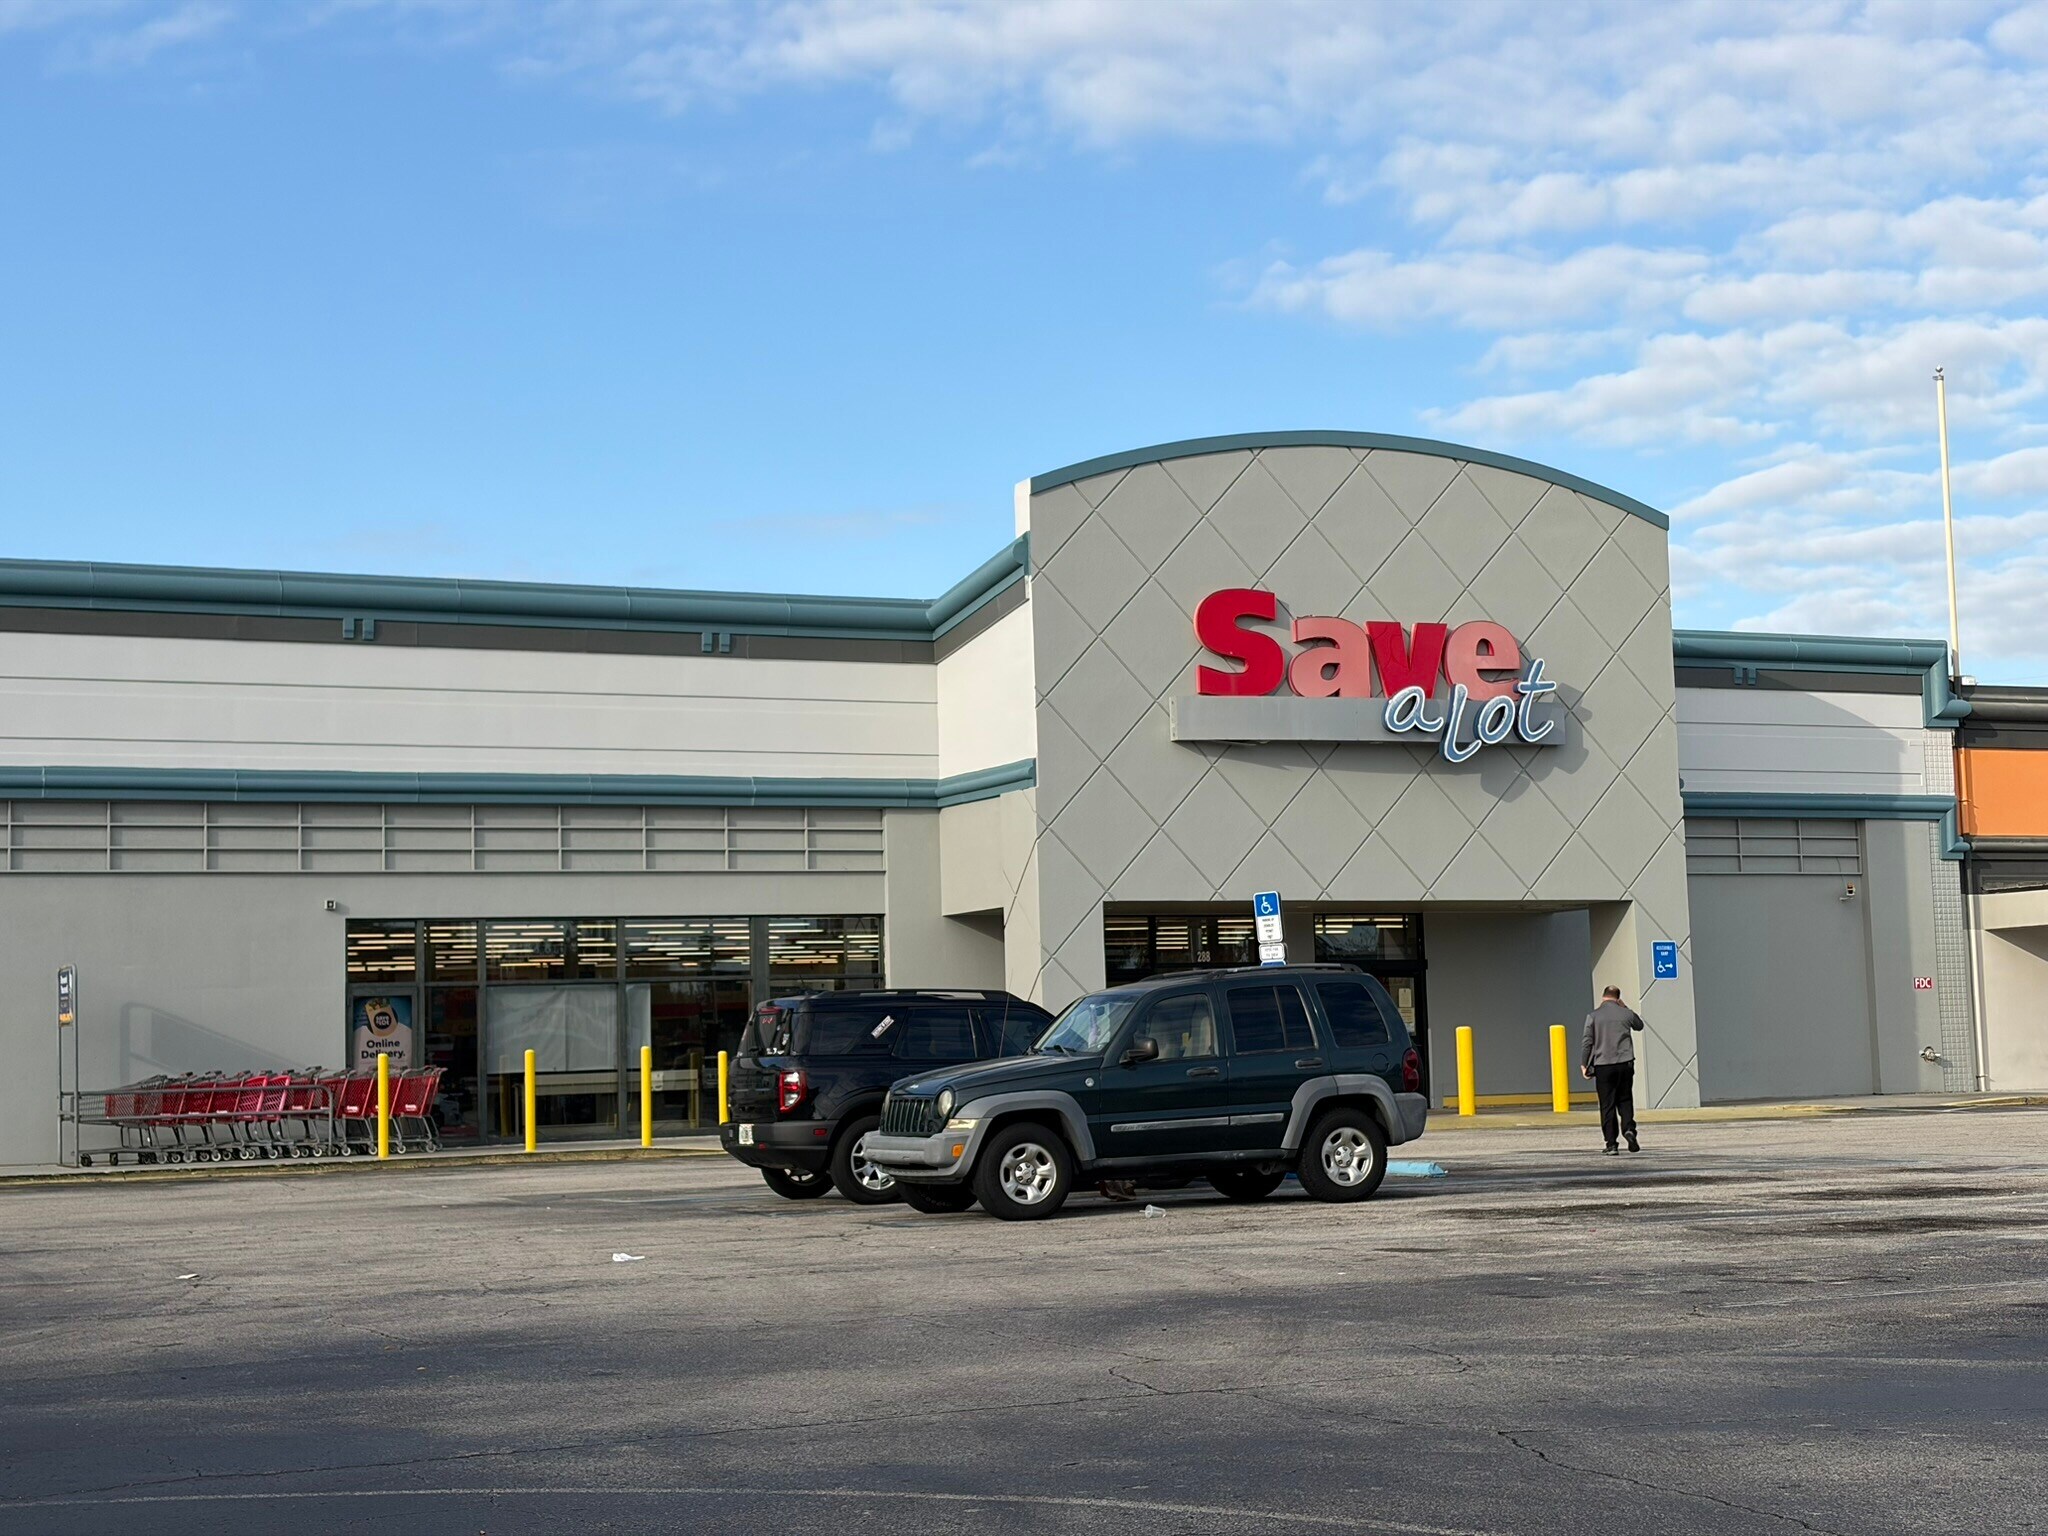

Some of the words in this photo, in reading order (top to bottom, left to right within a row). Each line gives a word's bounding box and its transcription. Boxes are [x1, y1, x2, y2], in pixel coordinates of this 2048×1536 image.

[1193, 588, 1521, 701] Save
[1383, 685, 1444, 733] a
[1196, 951, 1211, 962] 288
[1915, 977, 1931, 988] FDC
[366, 1039, 400, 1048] Online
[361, 1049, 405, 1059] Delery.
